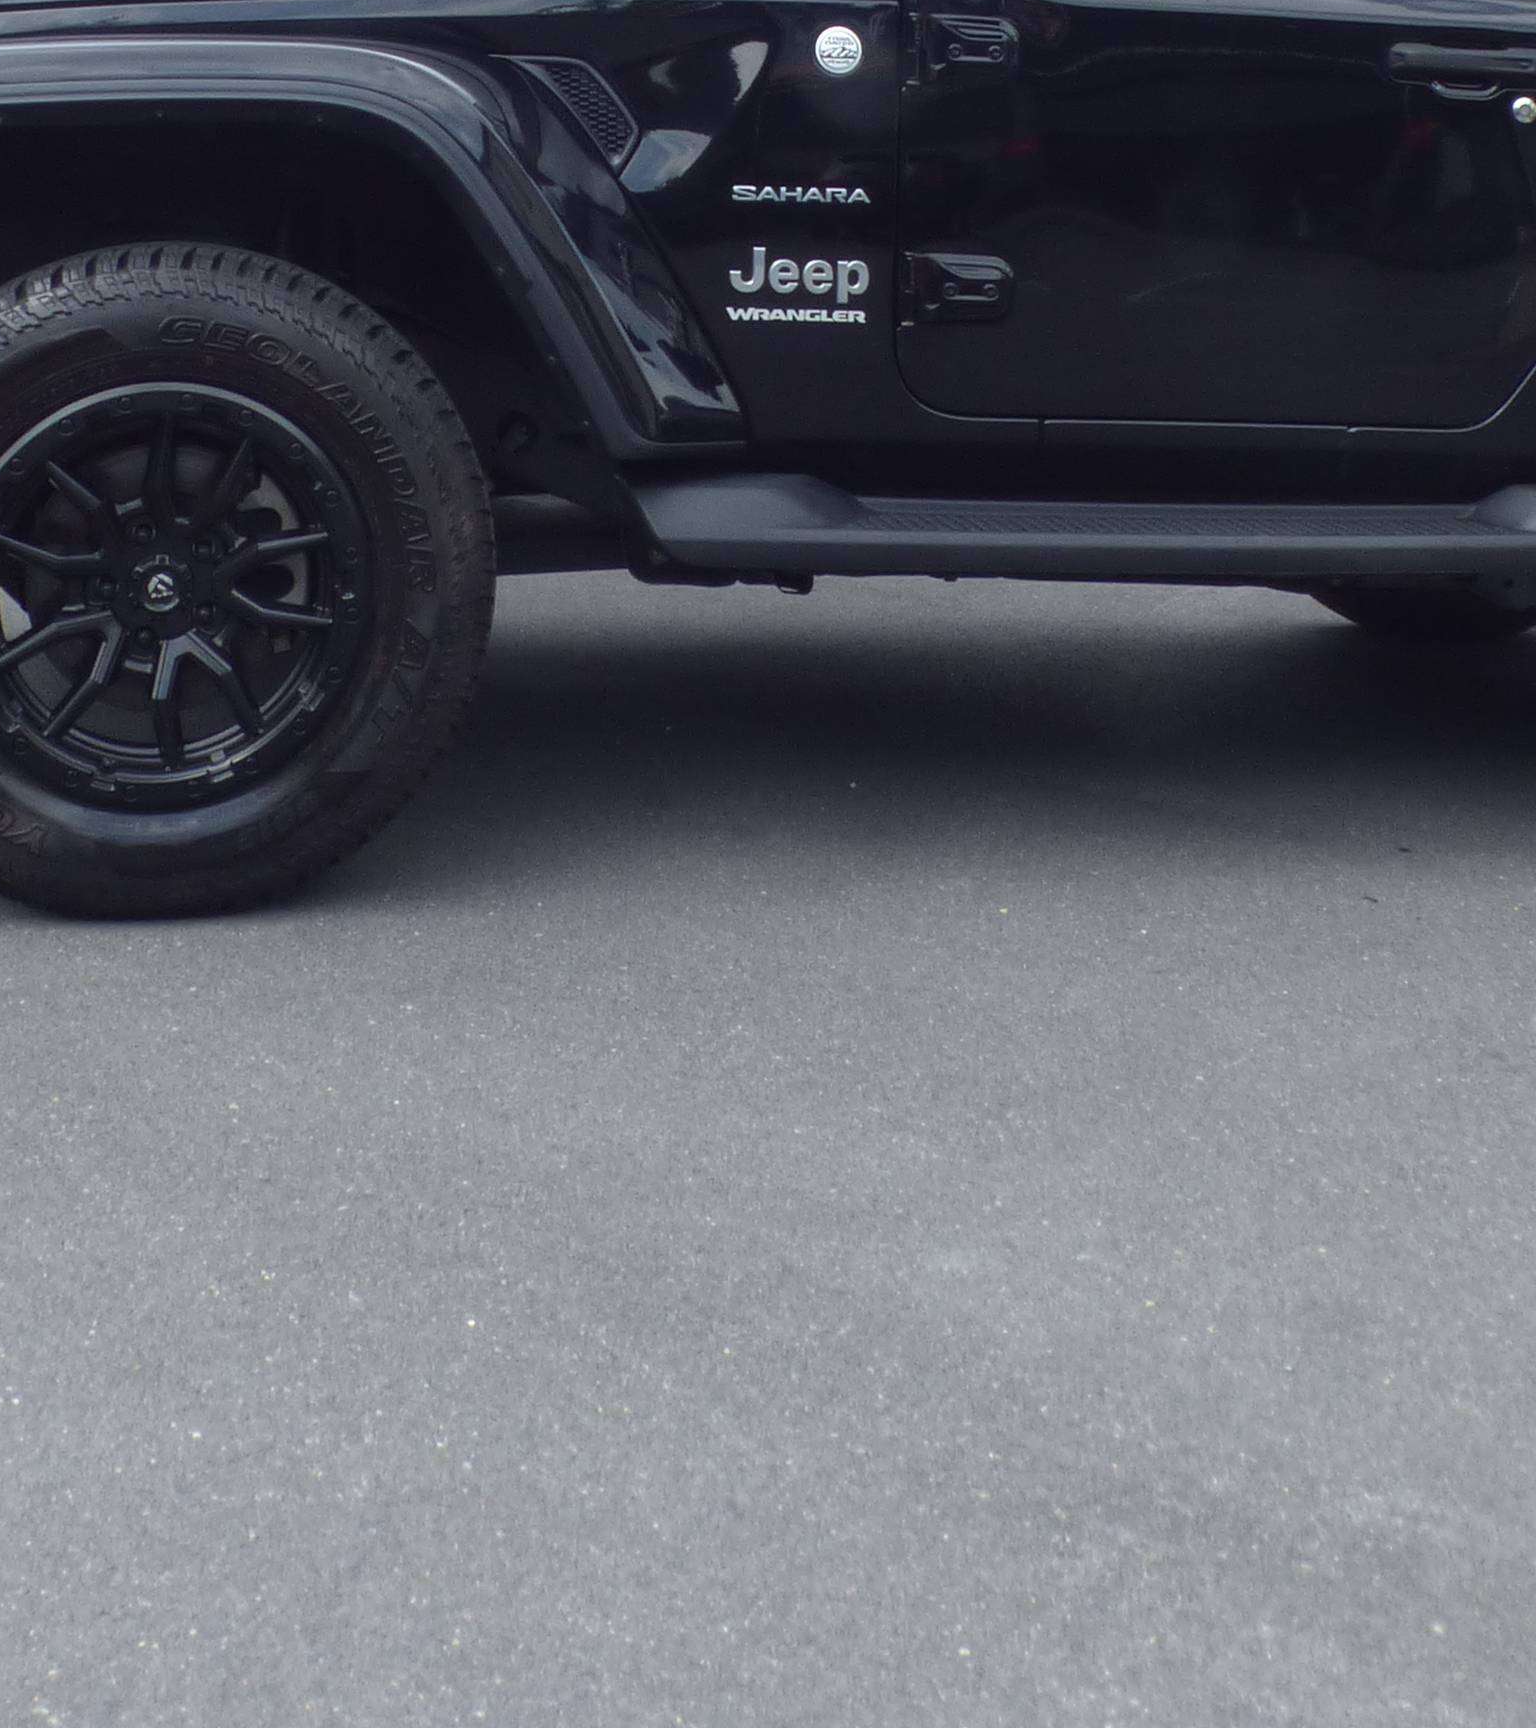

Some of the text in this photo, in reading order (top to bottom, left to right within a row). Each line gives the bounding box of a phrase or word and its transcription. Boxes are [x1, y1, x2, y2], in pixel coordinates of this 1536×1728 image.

[731, 184, 871, 204] SAHARA
[729, 246, 870, 304] Jeep
[725, 306, 867, 324] WRANGLER
[158, 315, 437, 595] GEOLANDAR
